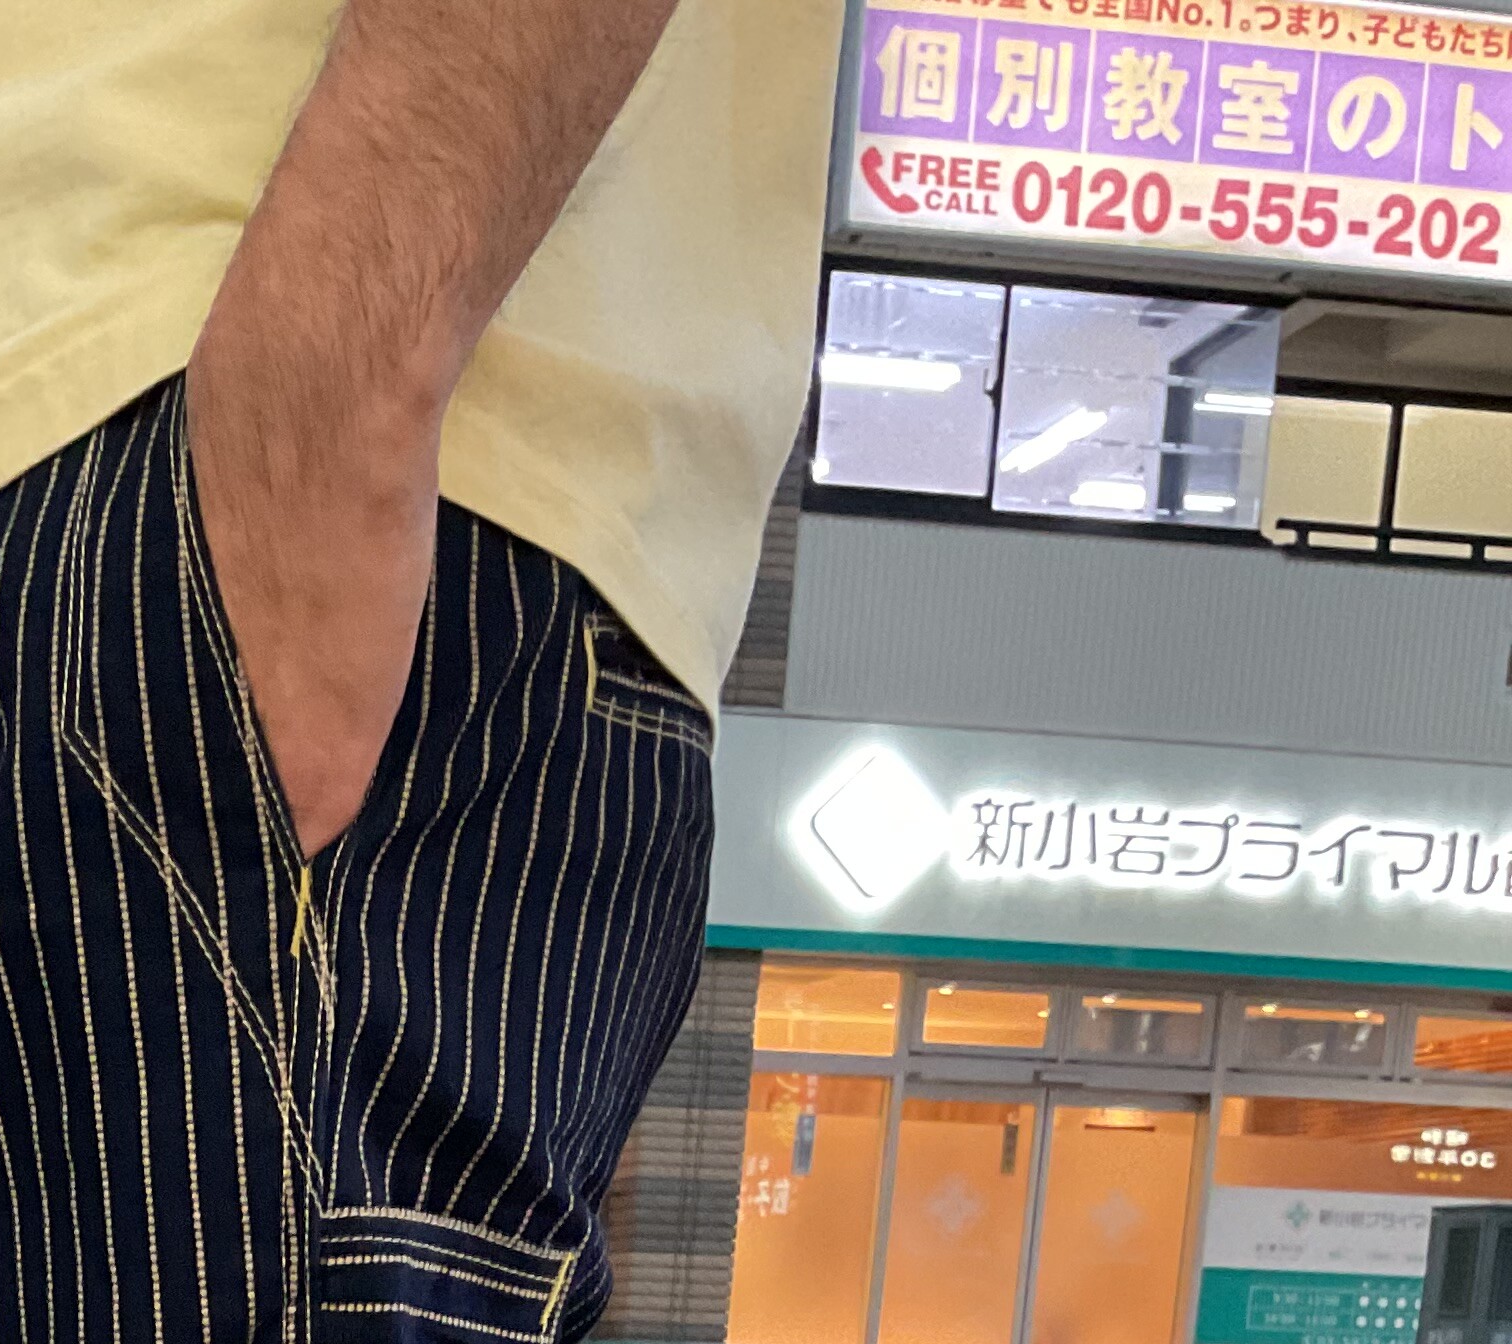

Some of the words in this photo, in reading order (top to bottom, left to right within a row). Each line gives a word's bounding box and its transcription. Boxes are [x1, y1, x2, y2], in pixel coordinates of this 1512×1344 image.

[876, 26, 1504, 171] 個別教室のト
[892, 152, 1002, 191] FREE
[924, 190, 999, 217] CALL
[1012, 161, 1501, 265] 0120-555-202
[967, 797, 1512, 898] 新小岩プライマル
